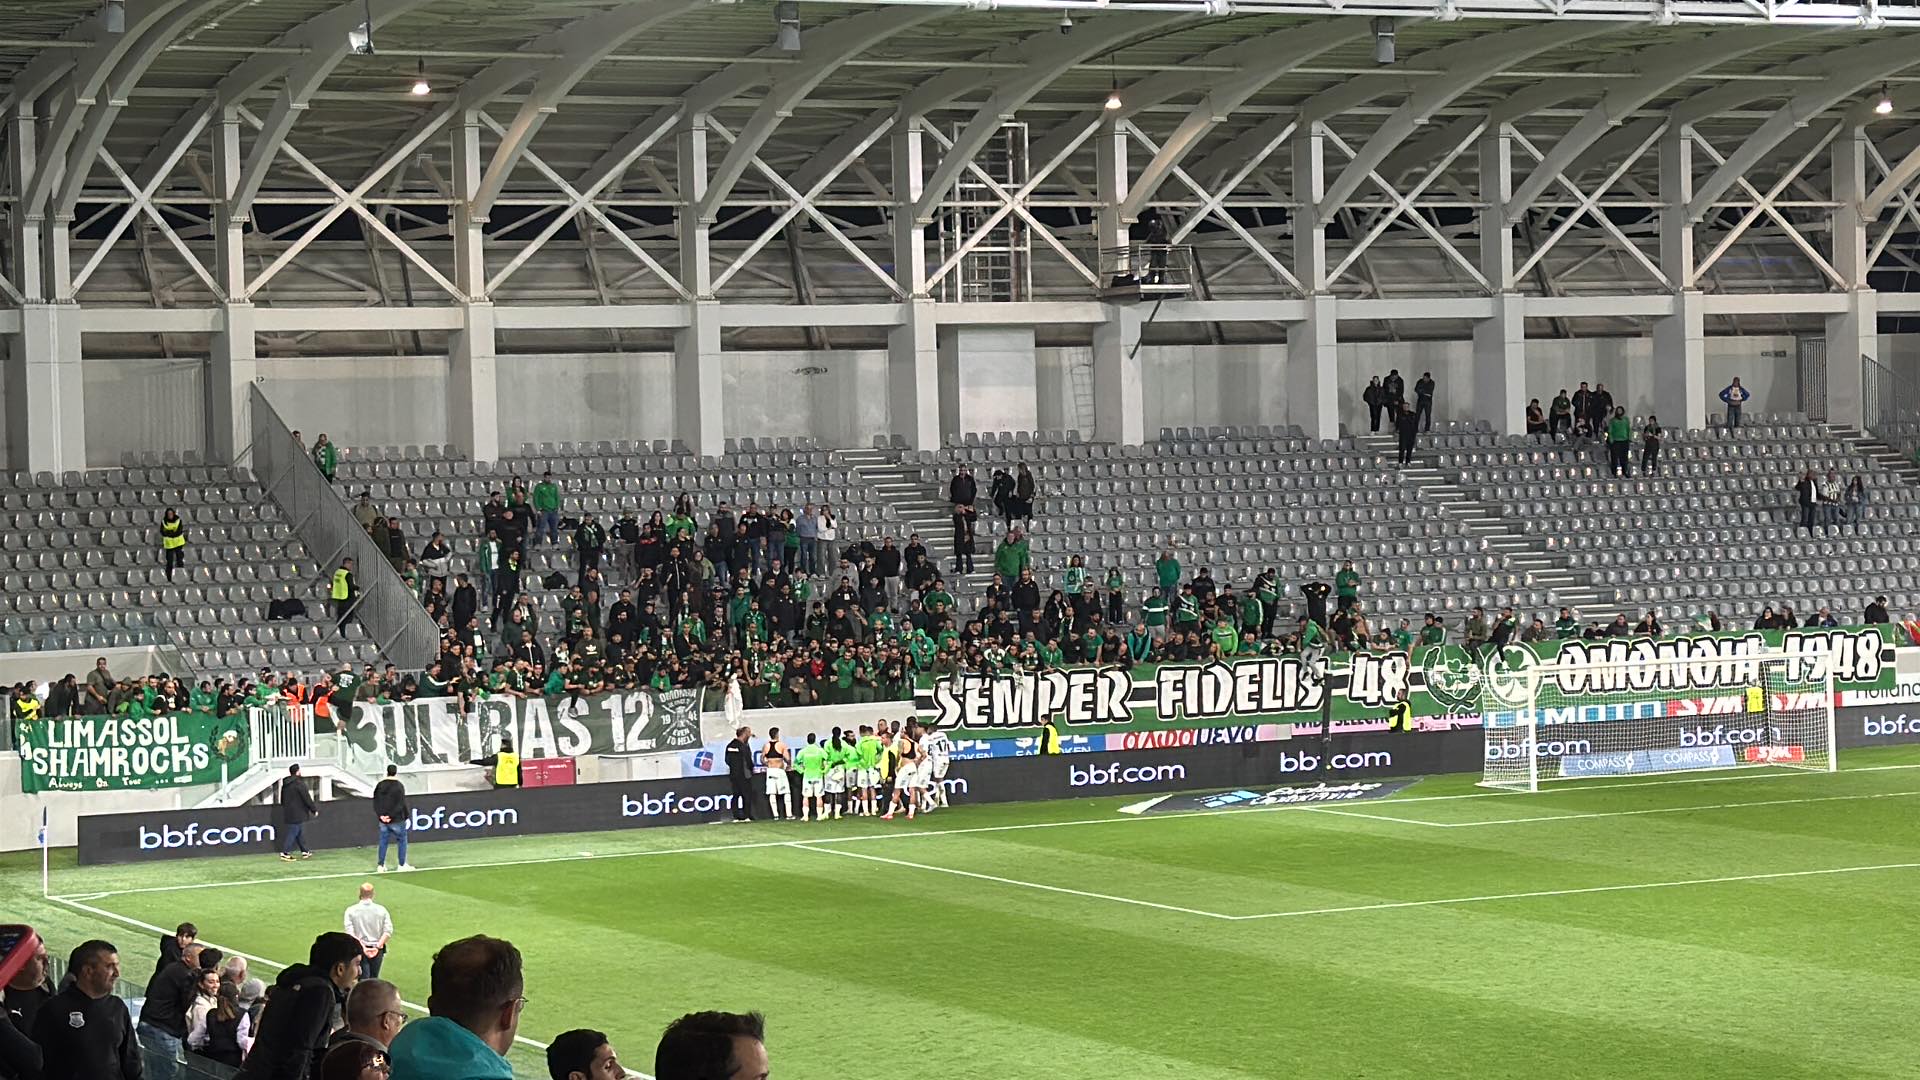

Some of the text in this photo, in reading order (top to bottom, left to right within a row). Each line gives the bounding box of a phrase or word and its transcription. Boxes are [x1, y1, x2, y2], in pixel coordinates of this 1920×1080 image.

[1784, 631, 1880, 682] 1948
[932, 652, 1409, 730] SEMPER FIDELIS 48
[48, 716, 190, 748] LIMASSOL
[382, 691, 656, 766] ULTRAS 12
[677, 733, 697, 745] HELL
[32, 743, 208, 776] SHAMROCKS
[1486, 739, 1591, 759] bbfcom
[1663, 750, 1711, 764] COMPASS
[1280, 751, 1391, 772] bb.com
[1577, 756, 1626, 771] COMPASS
[1069, 763, 1185, 786] bbf.com
[622, 792, 743, 816] bbf.com
[139, 823, 275, 849] bbf.com
